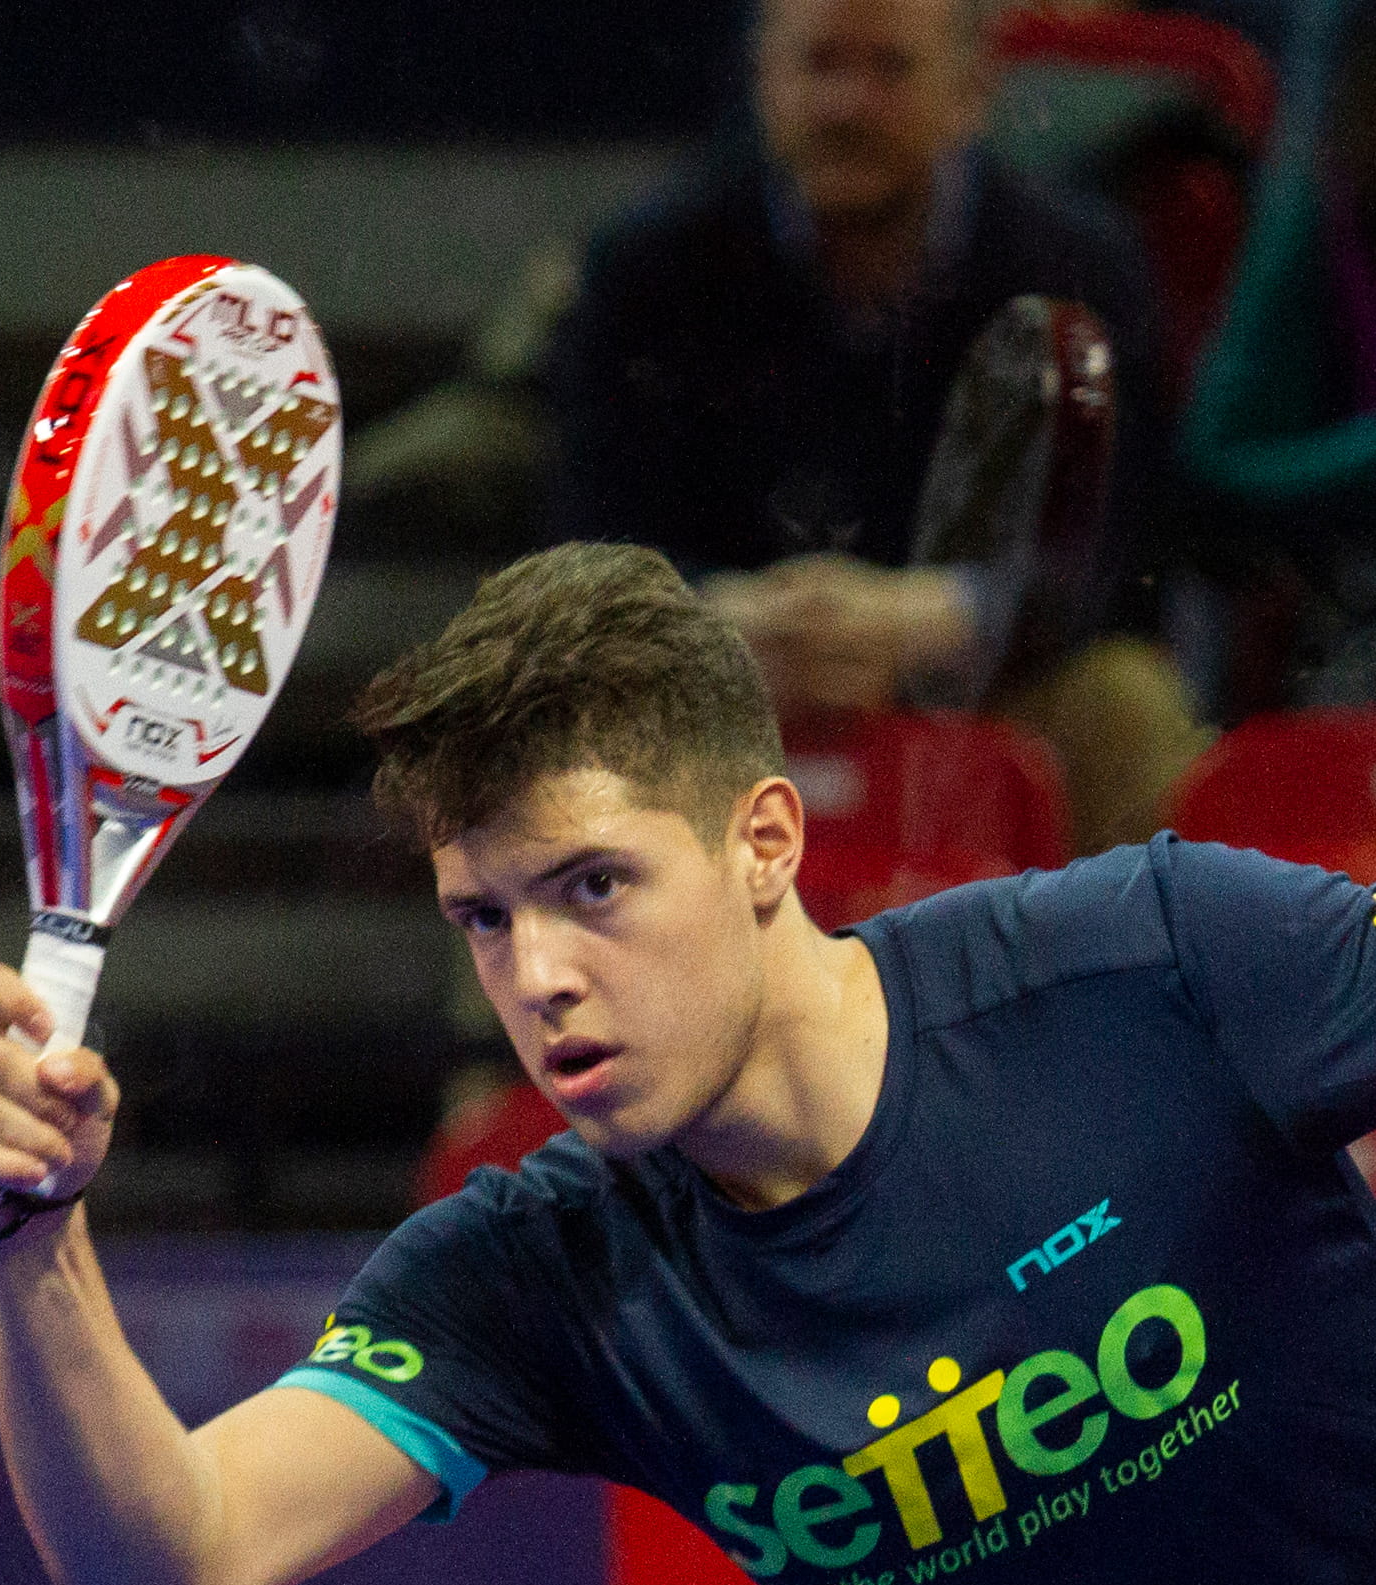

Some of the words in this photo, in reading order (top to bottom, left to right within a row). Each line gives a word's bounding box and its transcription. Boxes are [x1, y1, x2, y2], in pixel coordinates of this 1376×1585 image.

[1006, 1198, 1122, 1292] nox
[905, 1517, 1010, 1585] world
[1017, 1480, 1091, 1547] play
[1100, 1379, 1241, 1494] together
